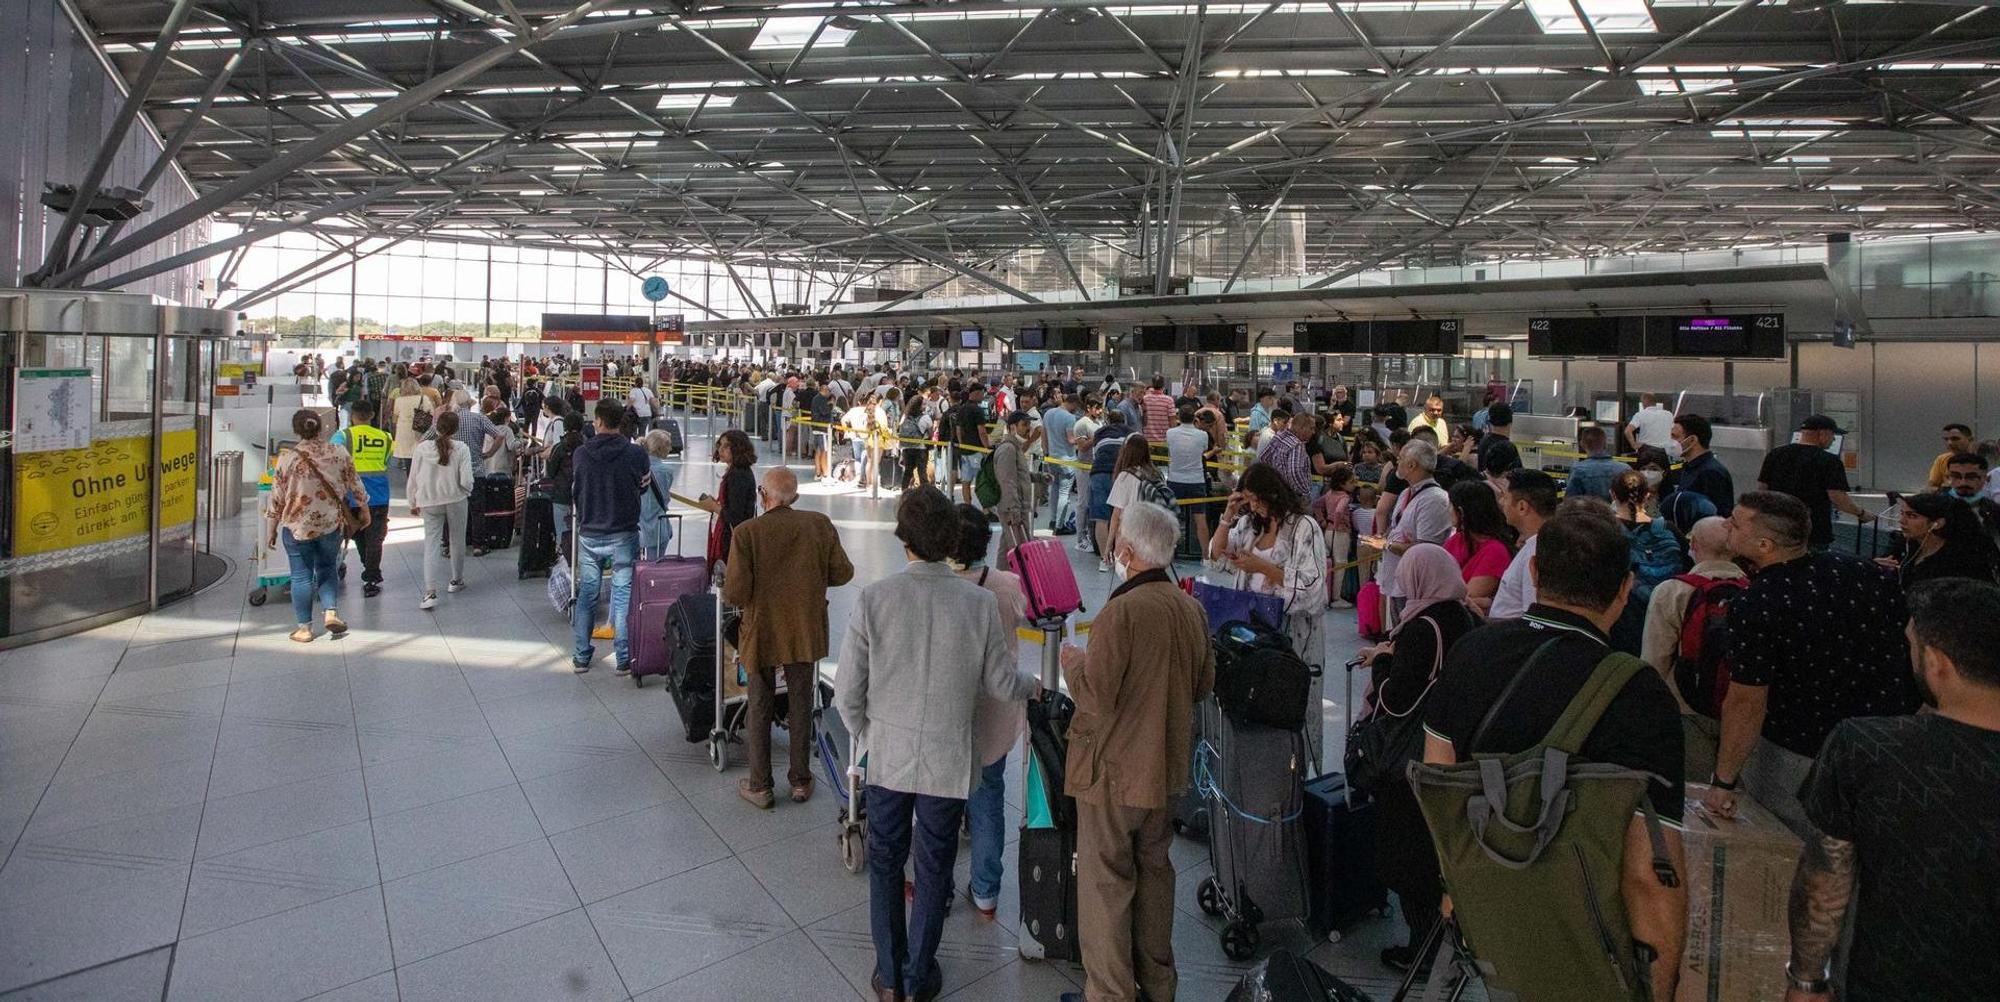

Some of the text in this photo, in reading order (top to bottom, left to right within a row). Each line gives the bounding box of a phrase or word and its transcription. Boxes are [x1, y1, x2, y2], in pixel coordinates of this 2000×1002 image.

[1440, 322, 1456, 331] 423
[1531, 320, 1549, 331] 422
[1756, 316, 1780, 328] 421
[1235, 325, 1247, 334] 425
[1296, 324, 1308, 333] 424
[355, 434, 385, 453] jto
[72, 473, 126, 498] Ohne
[75, 499, 121, 520] Einfach
[76, 519, 117, 537] direkt
[121, 511, 137, 522] am
